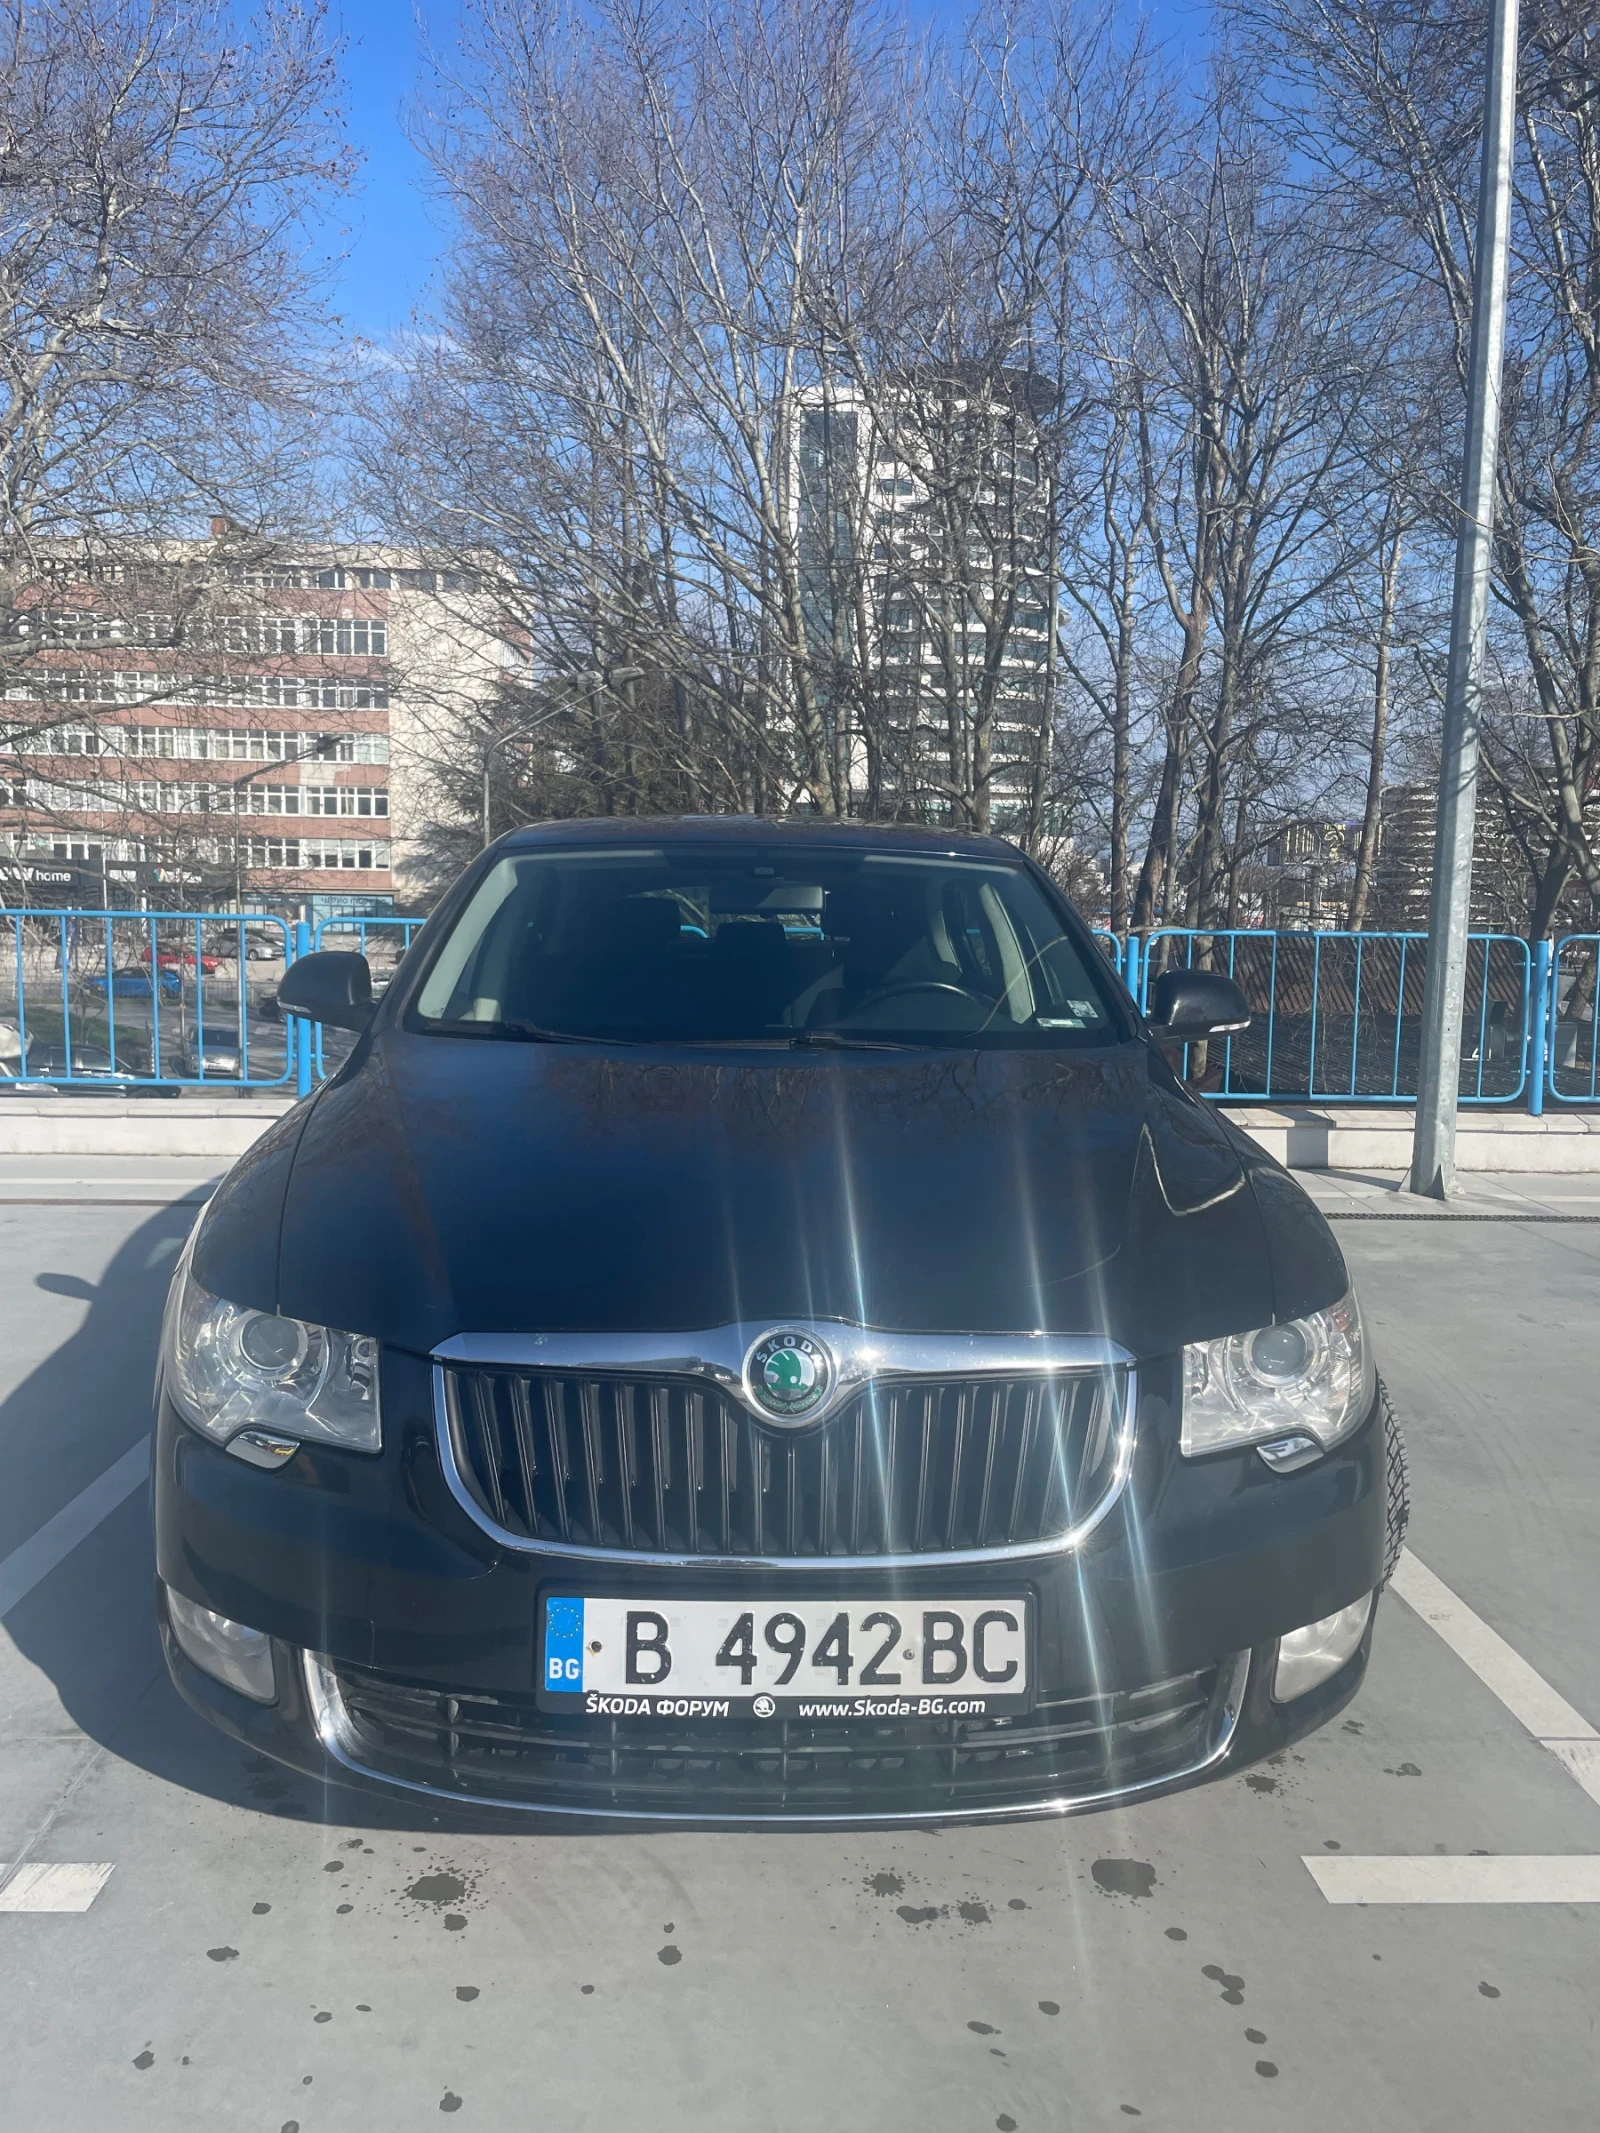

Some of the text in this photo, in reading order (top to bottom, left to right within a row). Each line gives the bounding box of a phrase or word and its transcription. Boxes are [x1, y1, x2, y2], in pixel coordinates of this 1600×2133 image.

[36, 869, 71, 881] home
[625, 1610, 1019, 1686] B 4942 BC
[549, 1657, 580, 1680] BG
[585, 1693, 730, 1717] ŠKODA ФОРУМ
[799, 1698, 986, 1717] www.Skoda-BG.com
